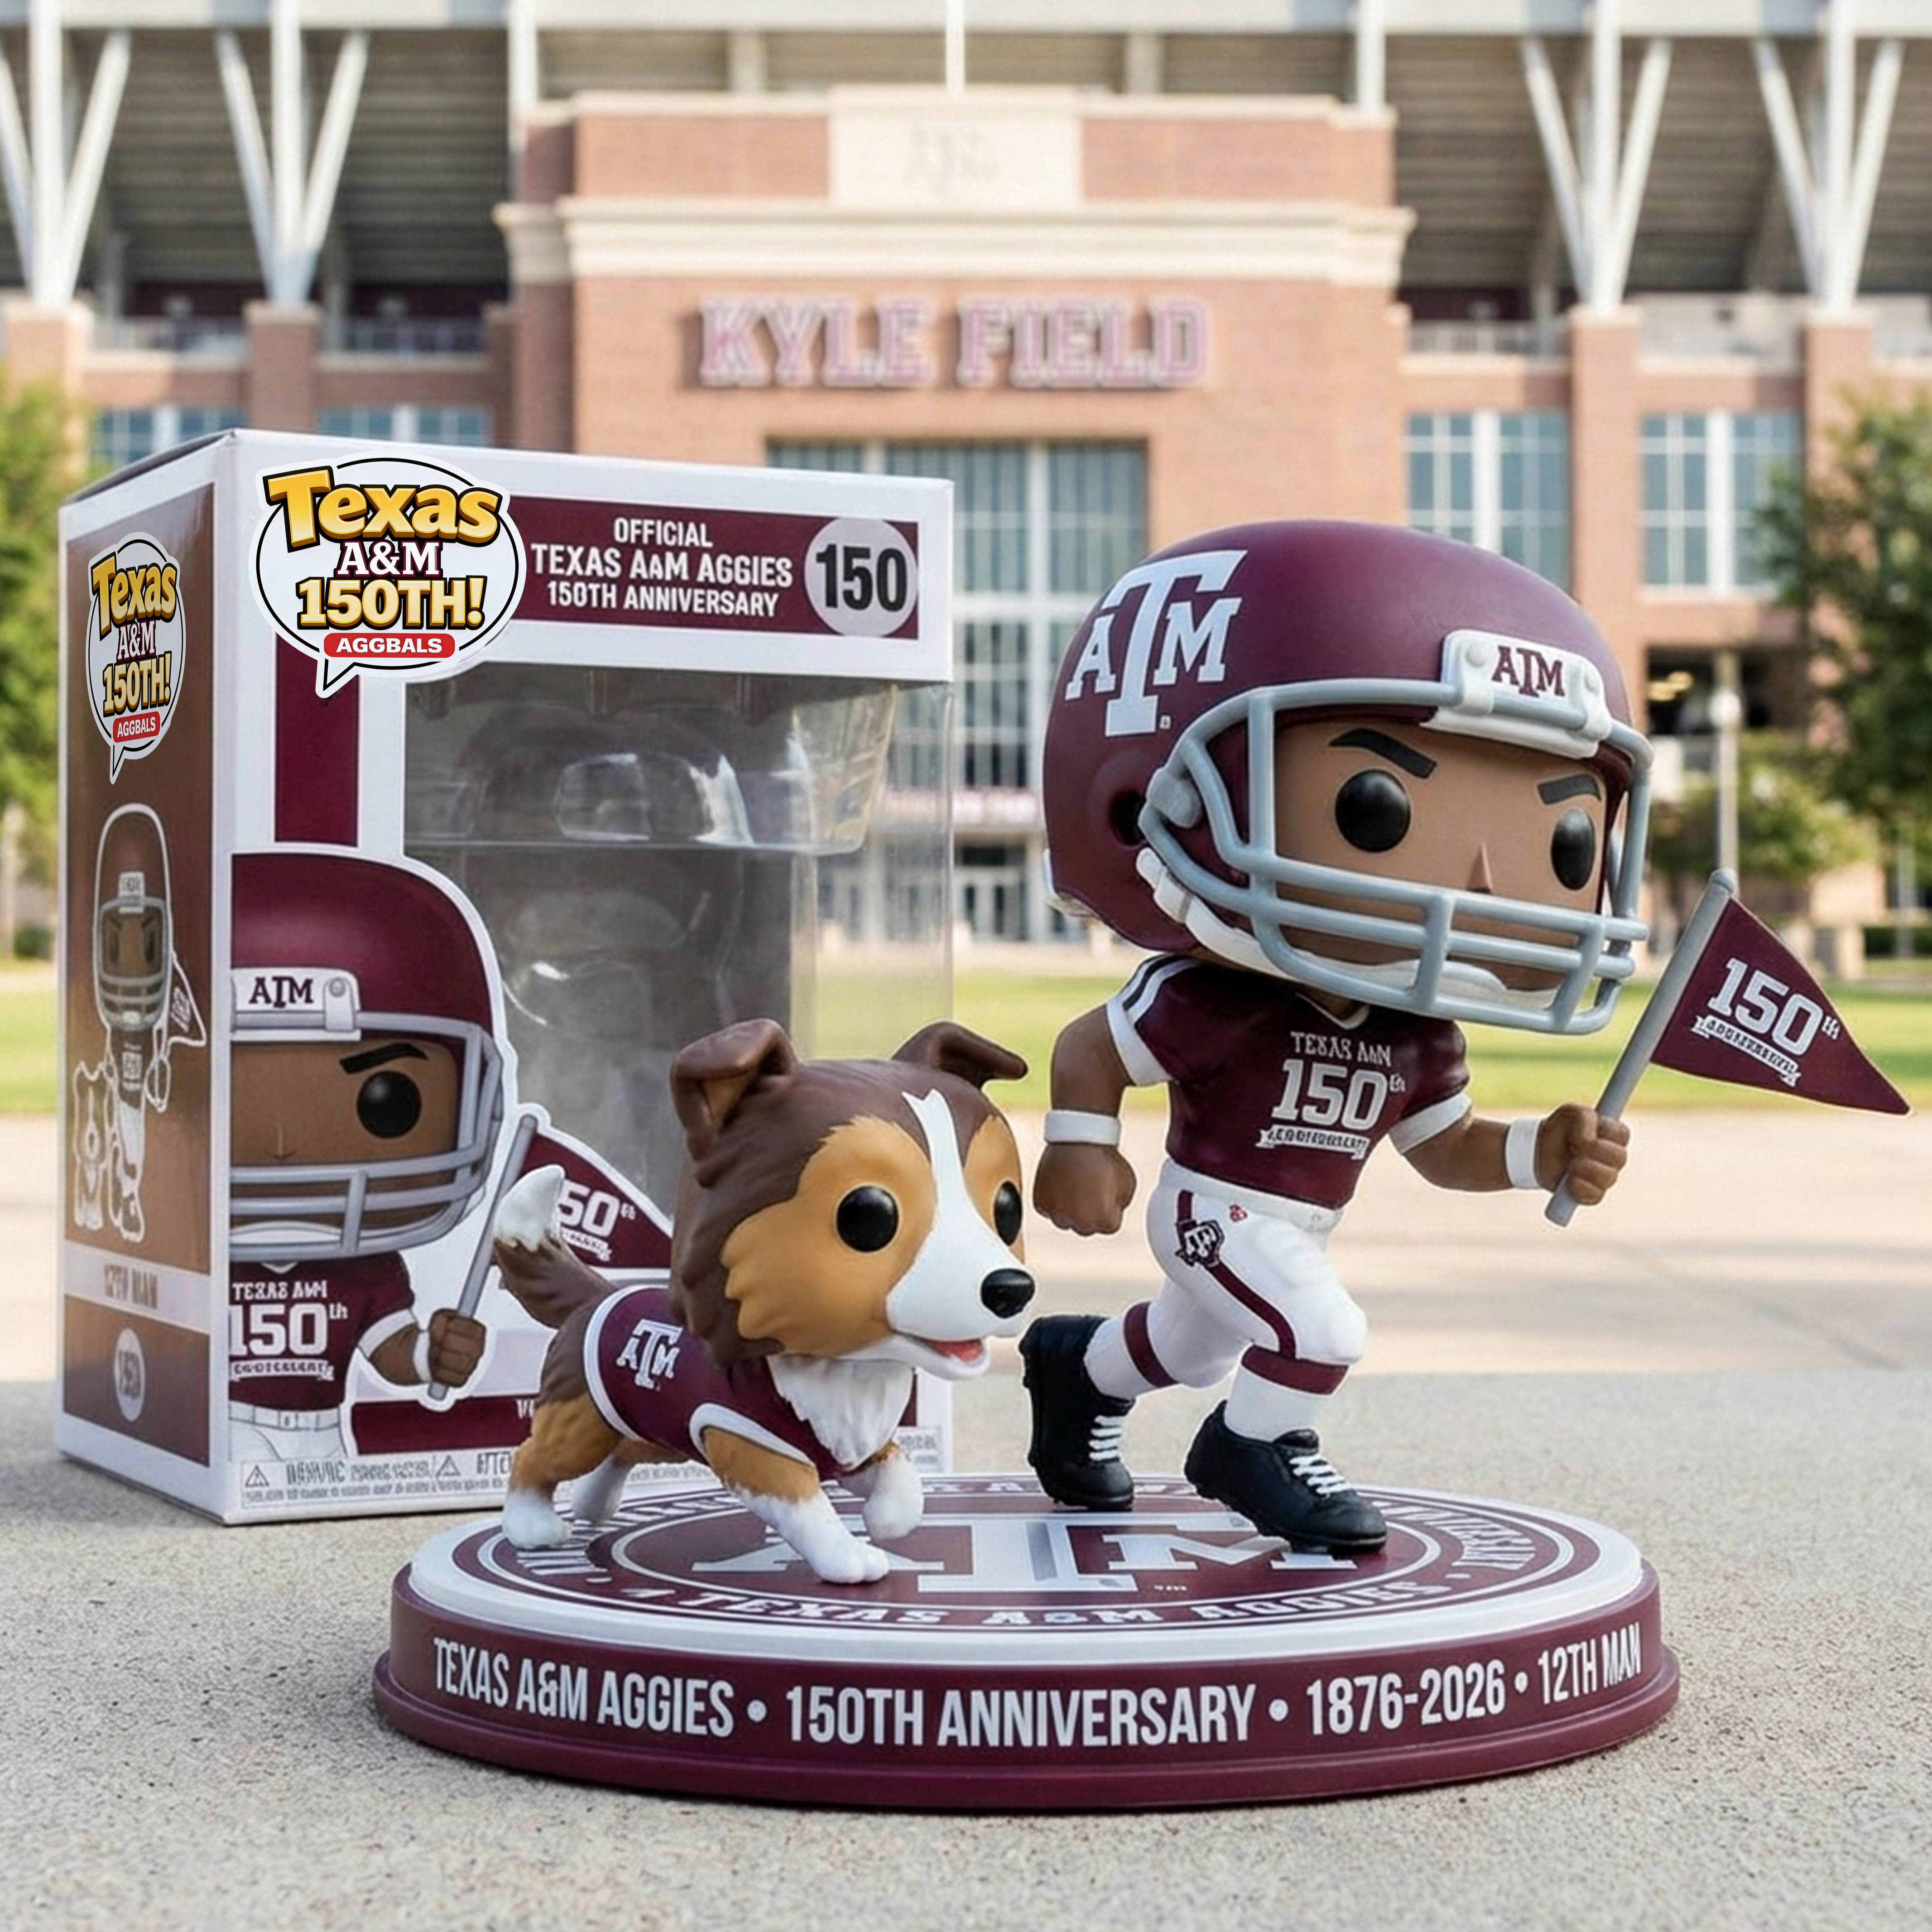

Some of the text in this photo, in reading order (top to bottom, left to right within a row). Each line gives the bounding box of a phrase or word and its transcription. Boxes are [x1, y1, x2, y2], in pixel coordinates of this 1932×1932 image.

[700, 293, 1211, 388] KYLE FIELD
[268, 469, 502, 548] Texas
[614, 517, 713, 547] OFFICIAL
[337, 541, 441, 576] A&M
[531, 543, 622, 578] TEXAS
[697, 553, 793, 587] AGGIES
[816, 543, 906, 612] 150
[92, 556, 177, 636] Texas
[299, 577, 484, 626] 150TH!
[548, 582, 779, 617] 150TH ANNIVERSARY
[117, 620, 155, 660] A&M
[336, 638, 442, 653] AGGBALS
[103, 654, 172, 714] 150TH!
[117, 716, 156, 738] AGGBALS
[678, 1592, 950, 1625] TEXAS
[433, 1620, 1641, 1747] TEXAS A&M AGGIES 150TH ANNIVERSARY 1876-2026 12TH MAN
